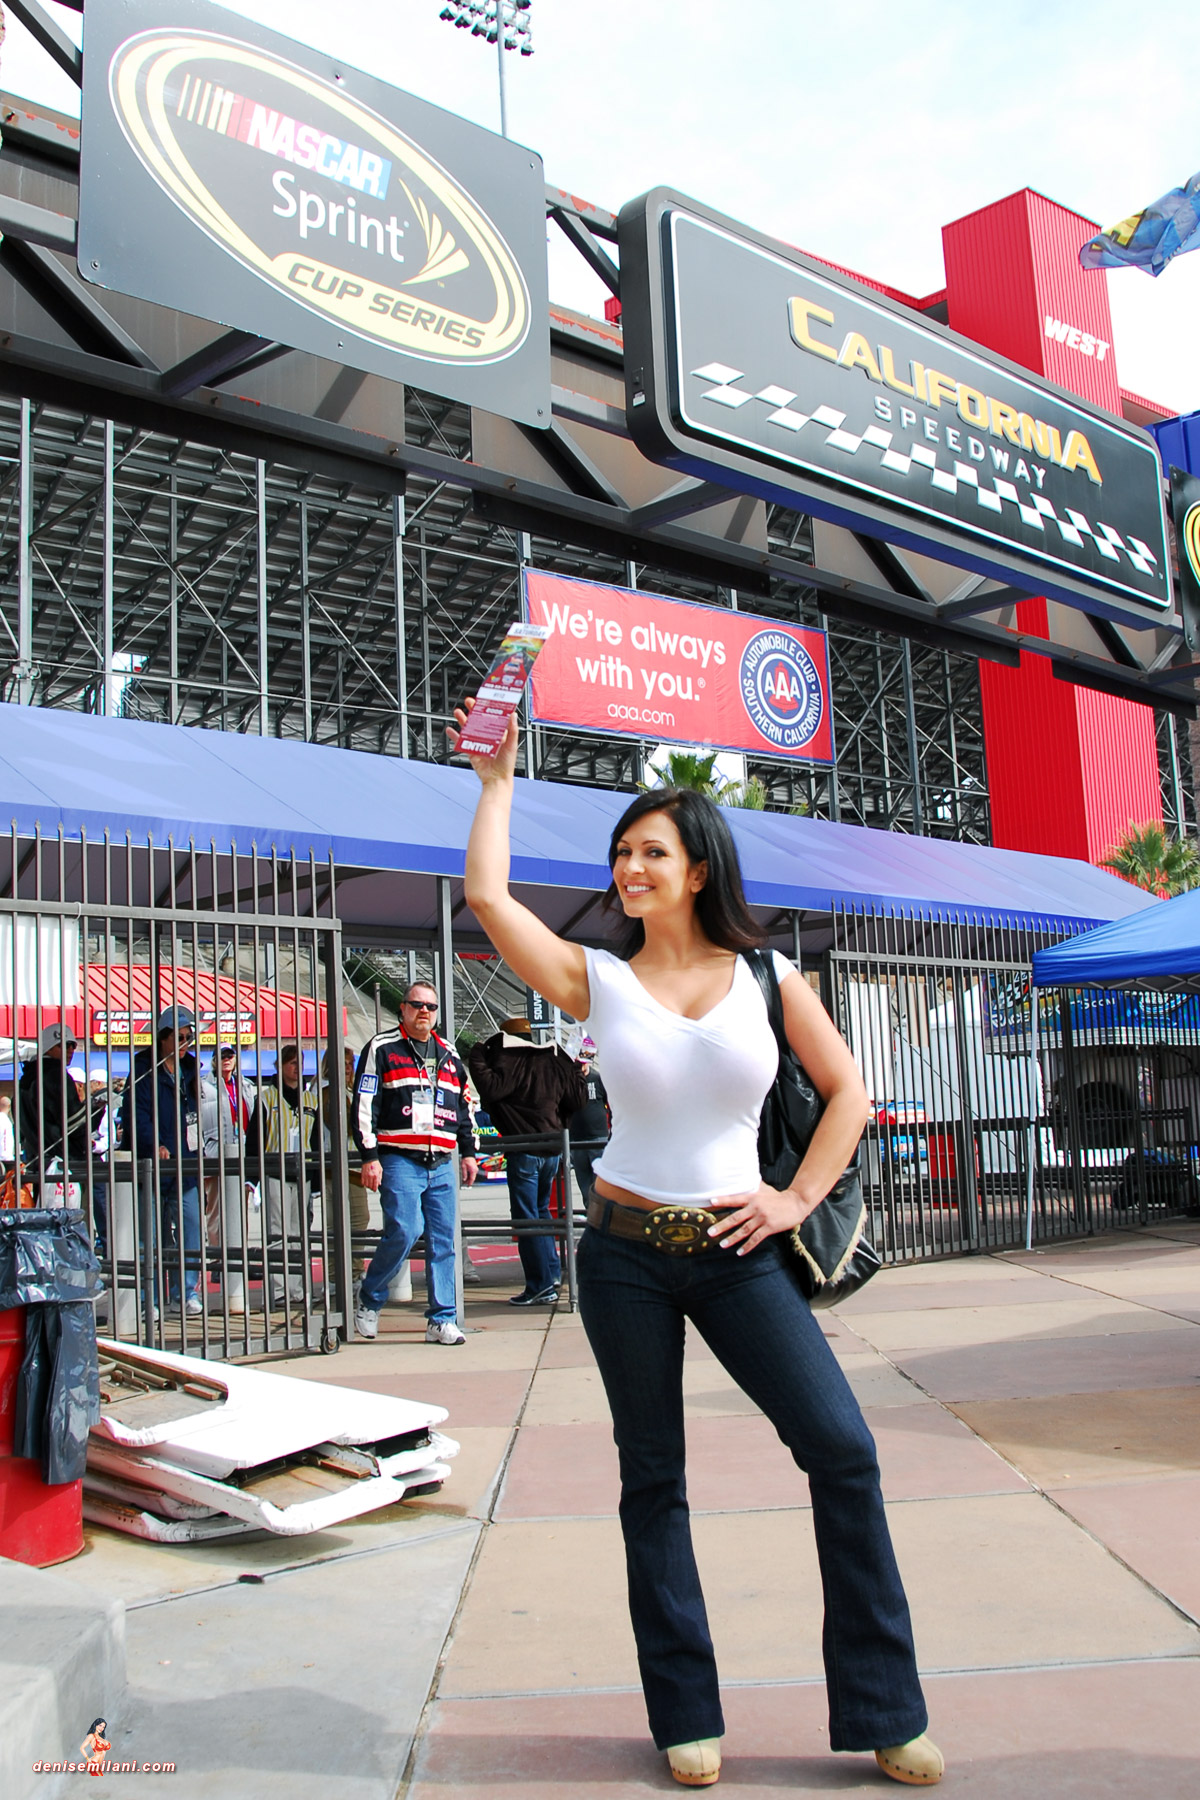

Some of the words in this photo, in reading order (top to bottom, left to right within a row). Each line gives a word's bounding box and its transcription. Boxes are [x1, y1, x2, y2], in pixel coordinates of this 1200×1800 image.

[246, 103, 384, 197] NASCAR
[271, 170, 405, 263] Sprint
[287, 262, 364, 300] CUP
[368, 292, 486, 348] SERIES
[1044, 315, 1111, 362] WEST
[788, 296, 1104, 486] CALIFORNIA
[873, 396, 1047, 488] SPEEDWAY
[541, 600, 623, 646] We're
[630, 622, 726, 668] always
[744, 634, 797, 672] AUTOMOBILE
[795, 650, 816, 684] CLUB
[575, 654, 634, 690] with
[764, 671, 802, 702] AAA
[607, 702, 676, 727] aaa.com
[743, 678, 783, 742] SOUTHERN
[784, 692, 820, 745] CALIFORNIA
[460, 739, 494, 754] ENTRY
[362, 1075, 376, 1089] GM
